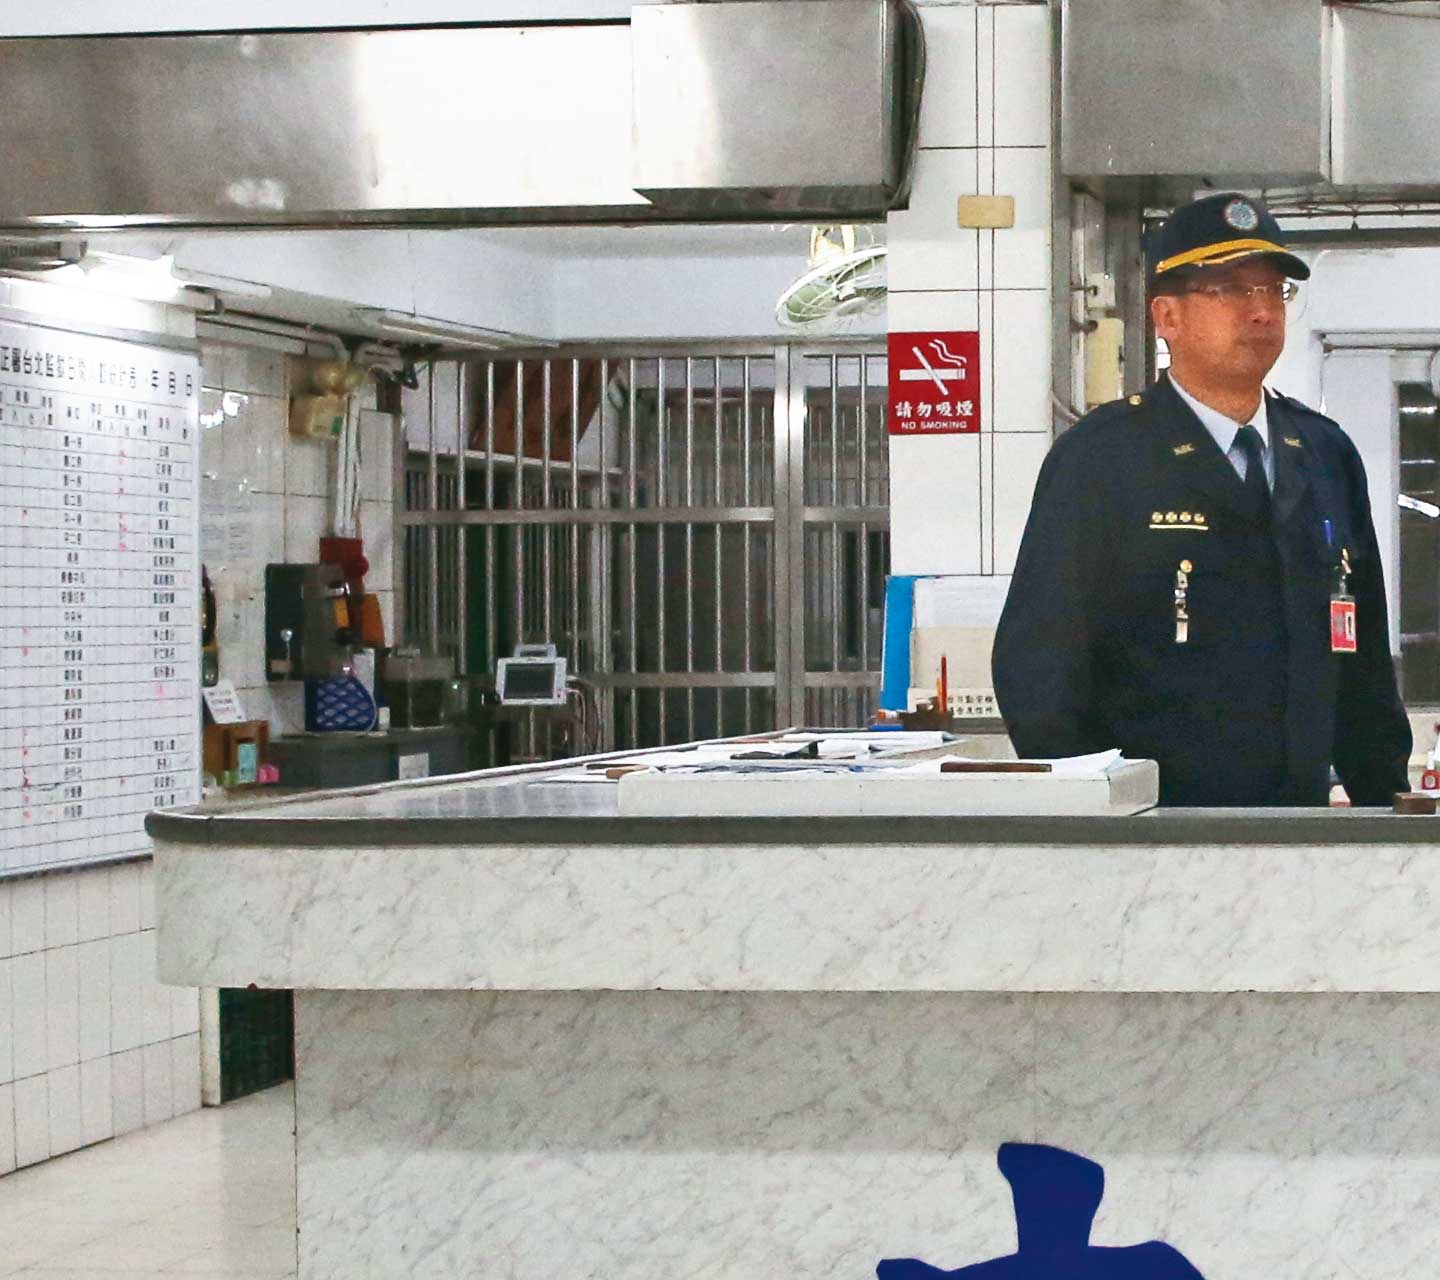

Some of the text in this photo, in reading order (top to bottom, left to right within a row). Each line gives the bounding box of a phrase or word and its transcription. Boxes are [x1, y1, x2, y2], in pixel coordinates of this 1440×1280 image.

[895, 401, 973, 418] 請勿吸煙
[901, 421, 968, 430] NO SMOKING
